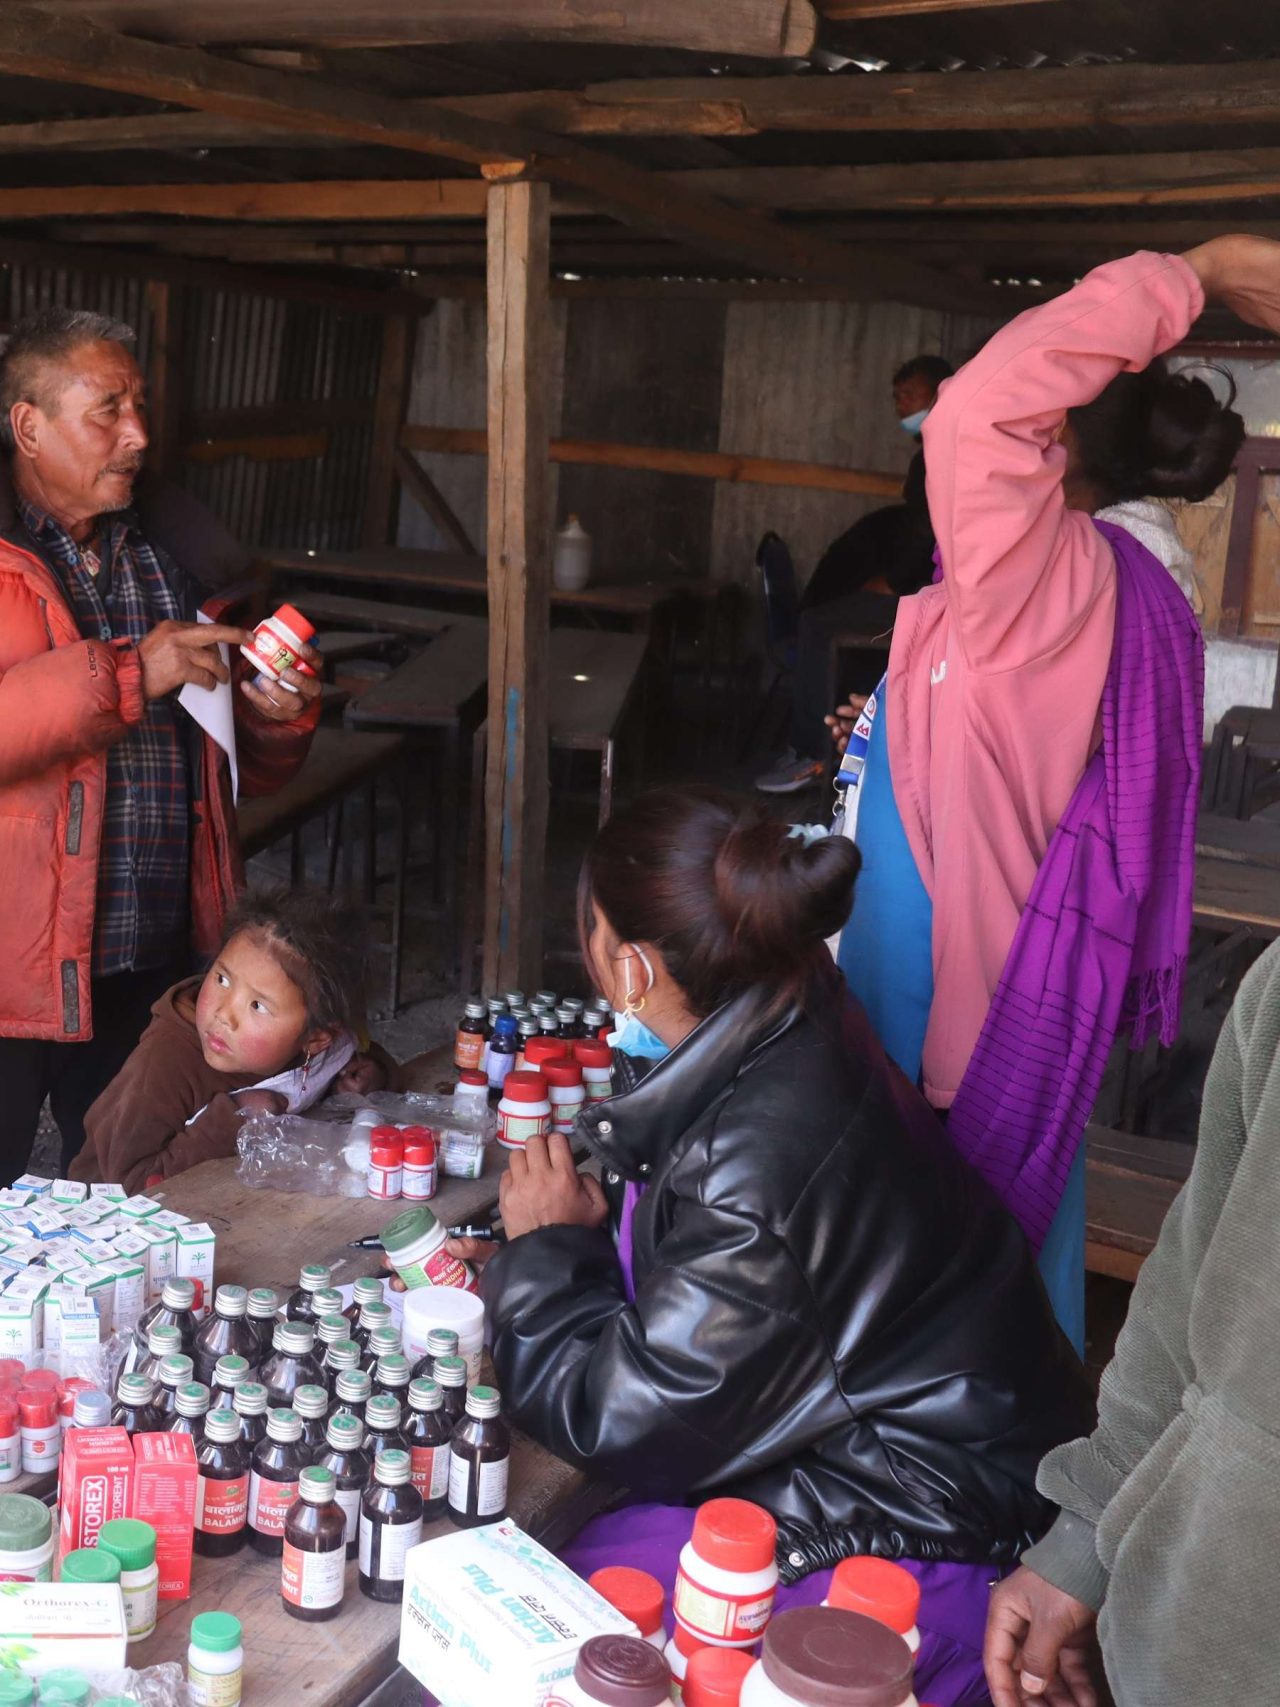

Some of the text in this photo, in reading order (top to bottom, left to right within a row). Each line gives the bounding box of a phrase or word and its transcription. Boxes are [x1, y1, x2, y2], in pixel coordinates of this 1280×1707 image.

[442, 1265, 465, 1285] ANDHAK
[83, 1480, 103, 1547] STOREX
[112, 1475, 123, 1520] CTORENT
[257, 1516, 284, 1529] BALA
[461, 1563, 505, 1596] Plus
